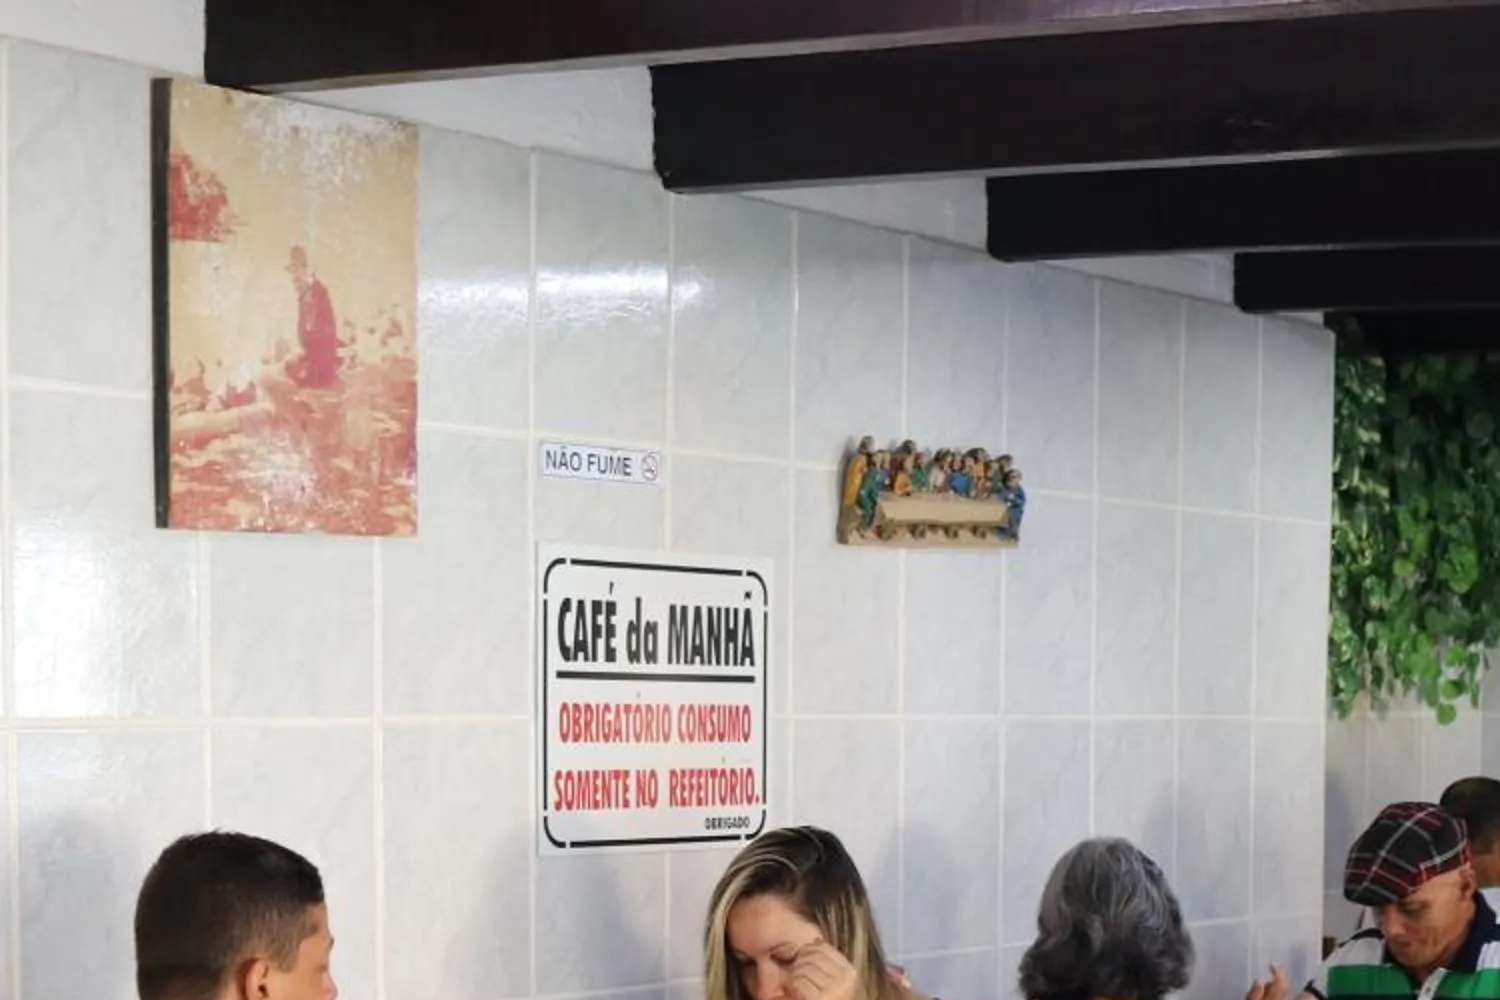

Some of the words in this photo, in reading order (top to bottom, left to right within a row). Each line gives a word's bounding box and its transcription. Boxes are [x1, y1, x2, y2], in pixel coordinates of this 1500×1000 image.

[545, 446, 582, 471] NÃO
[587, 453, 632, 476] FUME
[557, 581, 617, 663] CAFÉ
[626, 597, 659, 664] da
[667, 591, 755, 667] MANHÃ
[559, 691, 672, 743] OBRIGATÓRIO
[678, 703, 752, 743] CONSUMO
[554, 769, 630, 811] SOMENTE
[635, 769, 659, 808] NO
[703, 816, 751, 830] OBRIGADO
